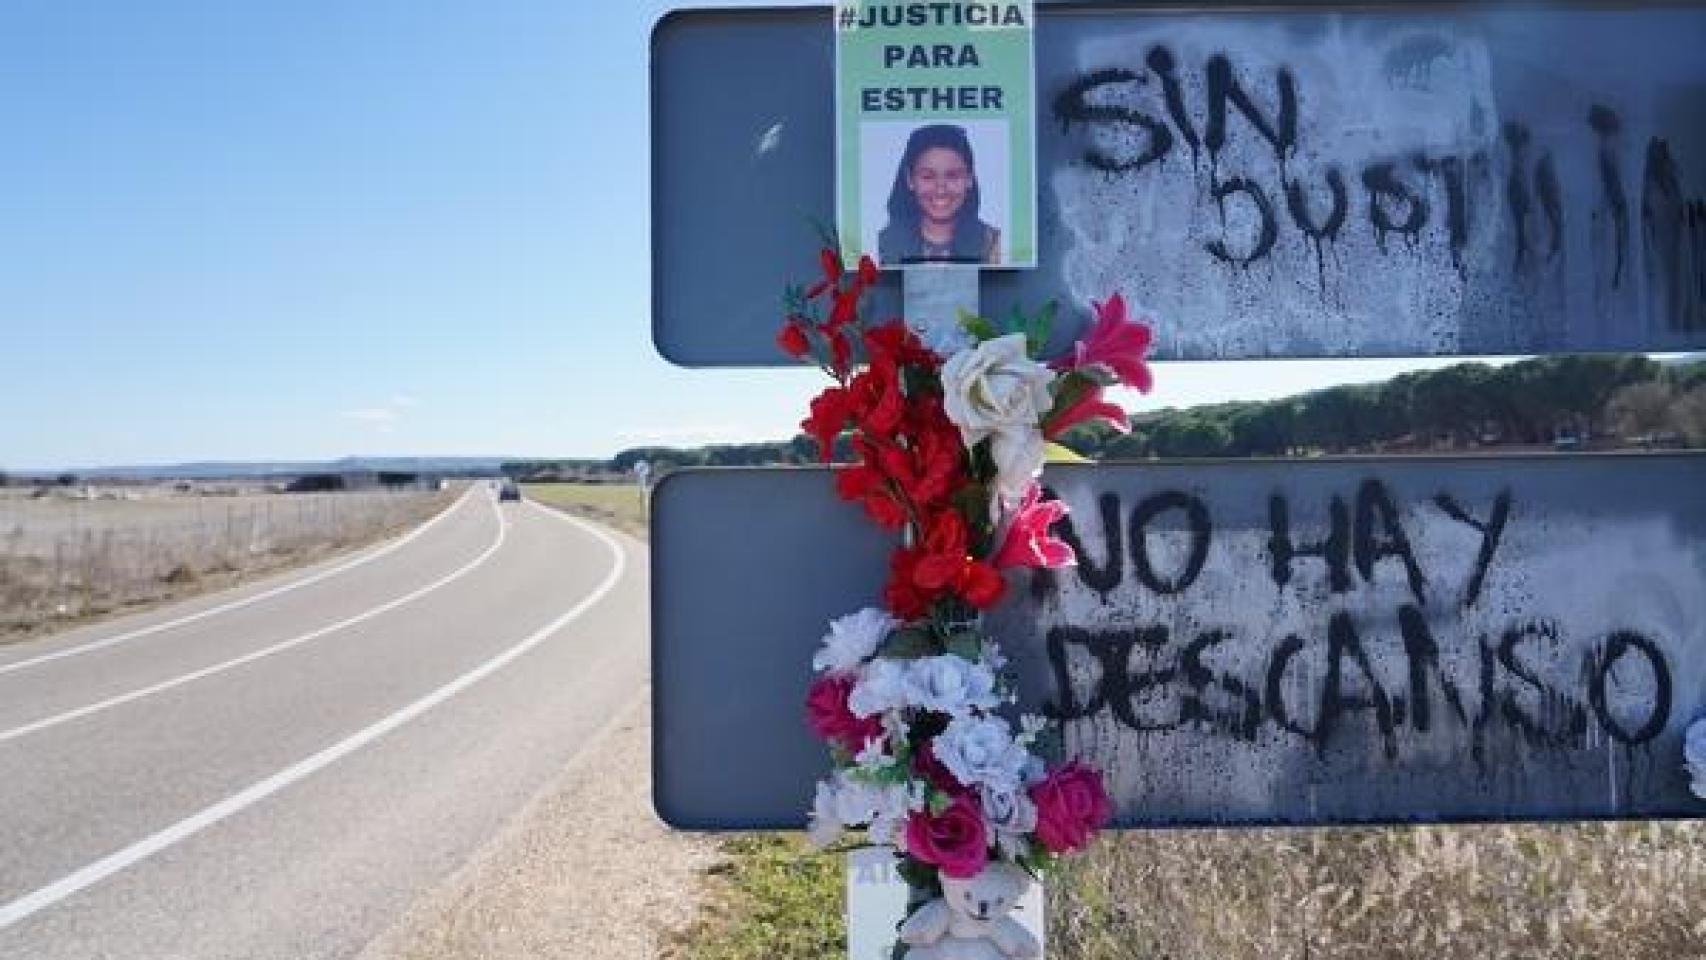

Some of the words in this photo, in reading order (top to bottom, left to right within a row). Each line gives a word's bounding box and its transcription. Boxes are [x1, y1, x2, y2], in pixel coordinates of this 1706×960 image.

[840, 3, 1025, 28] #JUSTICIA
[883, 44, 979, 69] PARA
[861, 85, 1004, 111] ESTHER
[1053, 45, 1297, 172] SIN
[1266, 478, 1511, 606] HAY
[1044, 604, 1673, 757] DESCANSO
